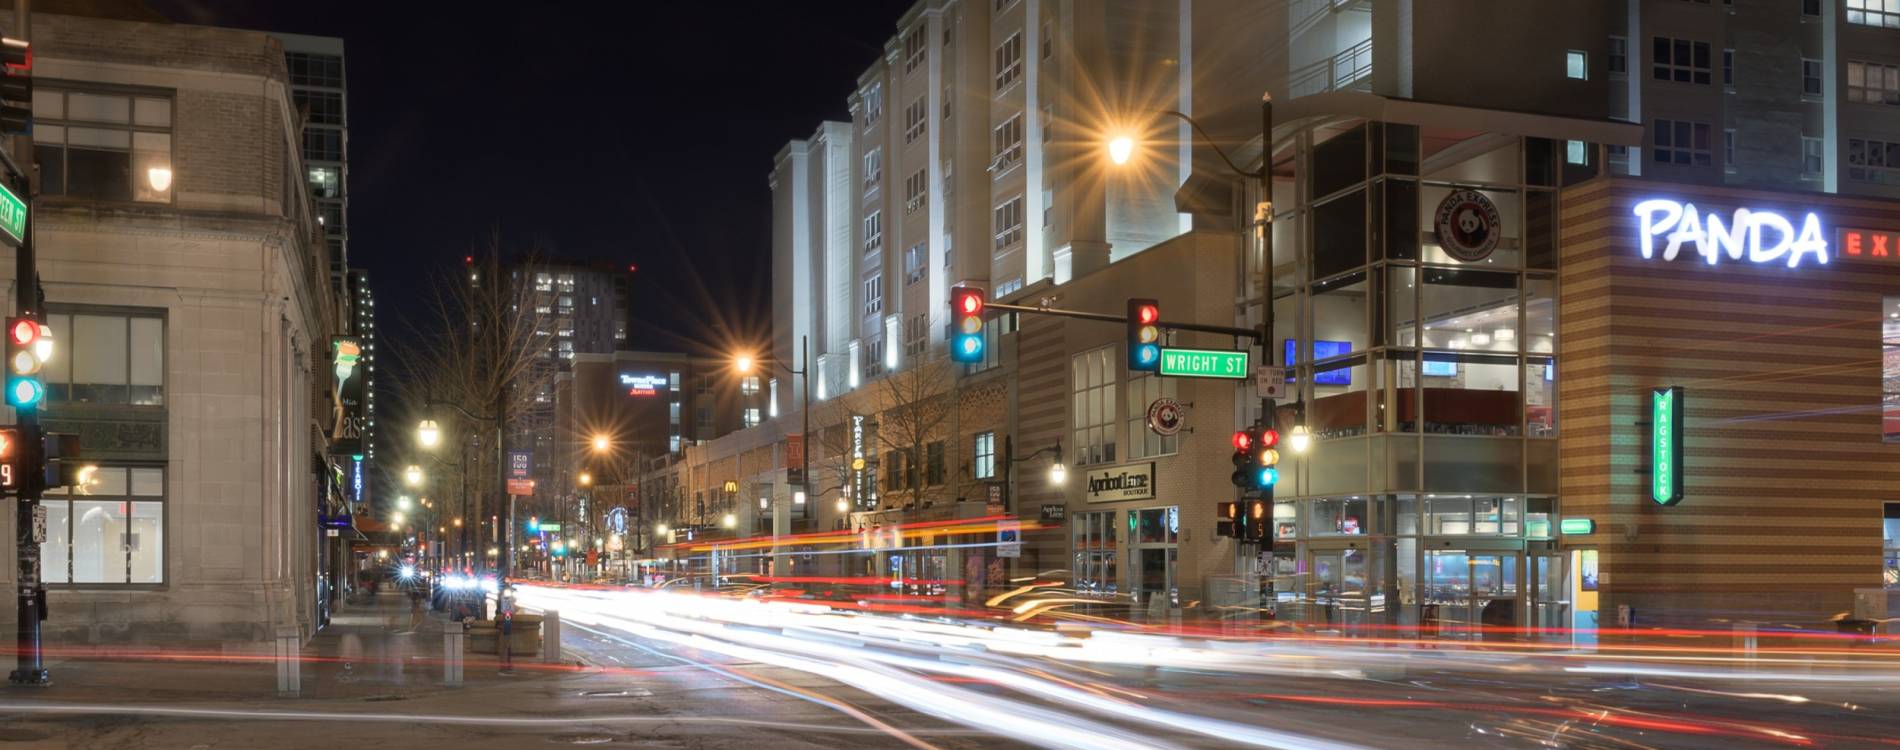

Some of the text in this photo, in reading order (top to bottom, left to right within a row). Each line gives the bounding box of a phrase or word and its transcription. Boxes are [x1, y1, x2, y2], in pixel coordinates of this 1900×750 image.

[15, 208, 24, 233] ST
[1441, 191, 1499, 228] PANDA EXPRESS
[1634, 198, 1829, 268] PANDA
[1166, 354, 1243, 373] WRIGHT ST
[1659, 400, 1667, 496] RAGSTOCK
